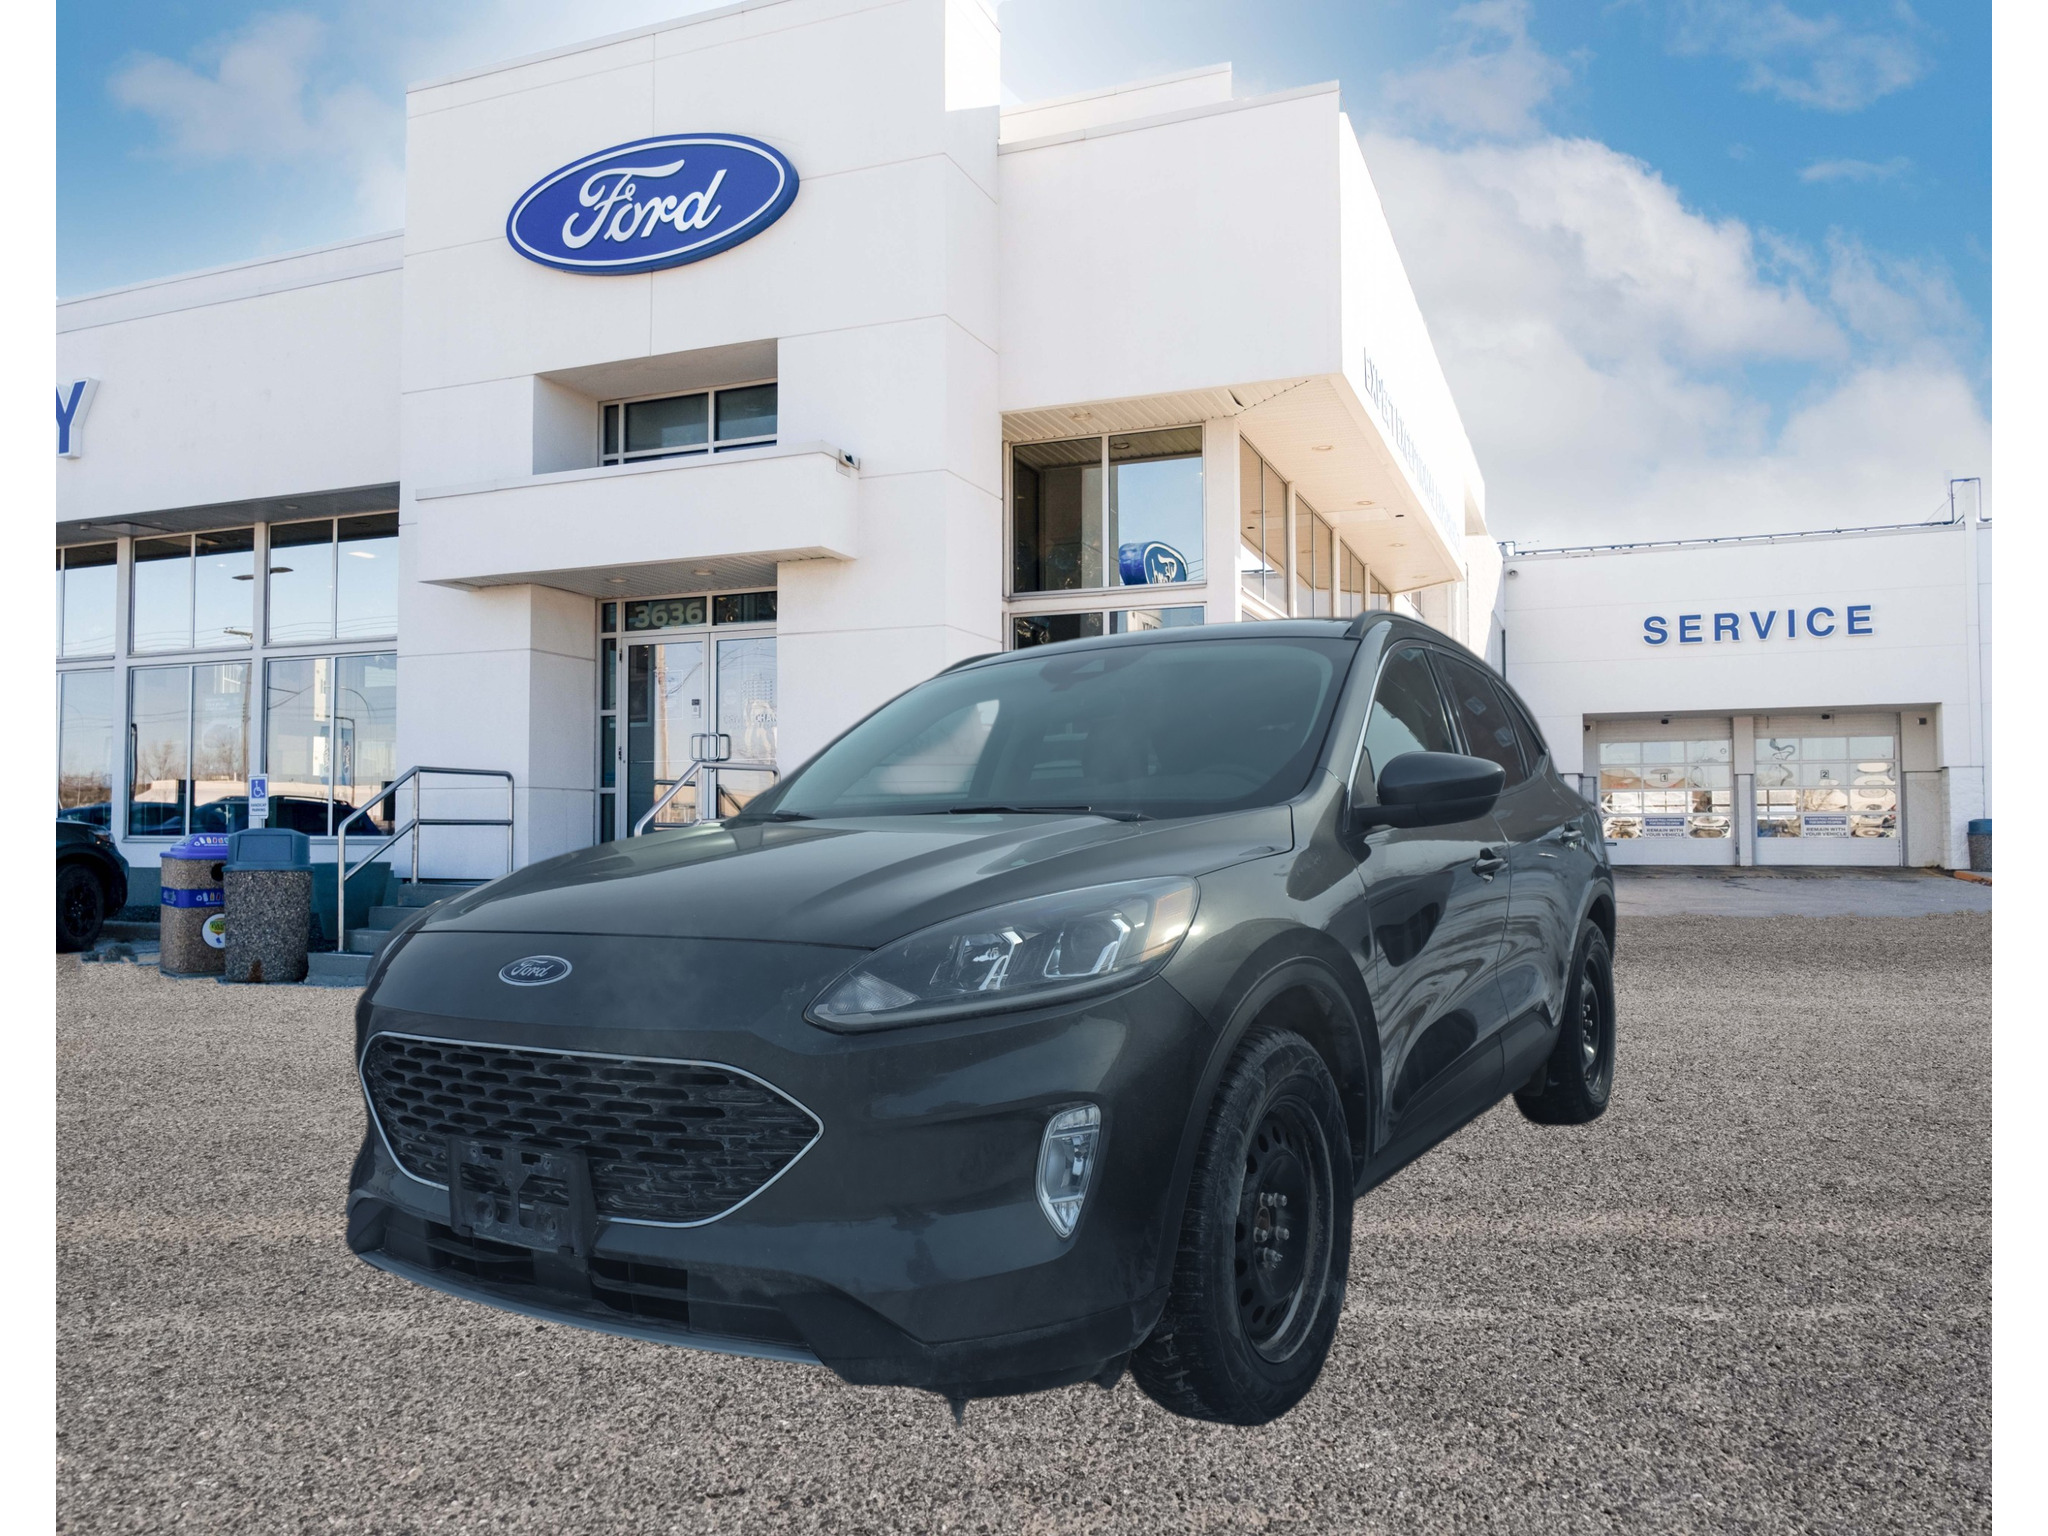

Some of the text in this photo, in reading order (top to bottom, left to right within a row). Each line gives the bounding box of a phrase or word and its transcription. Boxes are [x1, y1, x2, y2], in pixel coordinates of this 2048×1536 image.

[562, 159, 727, 249] Ford
[634, 601, 703, 628] 3636
[1643, 604, 1874, 645] SERVICE
[511, 959, 555, 978] Ford
